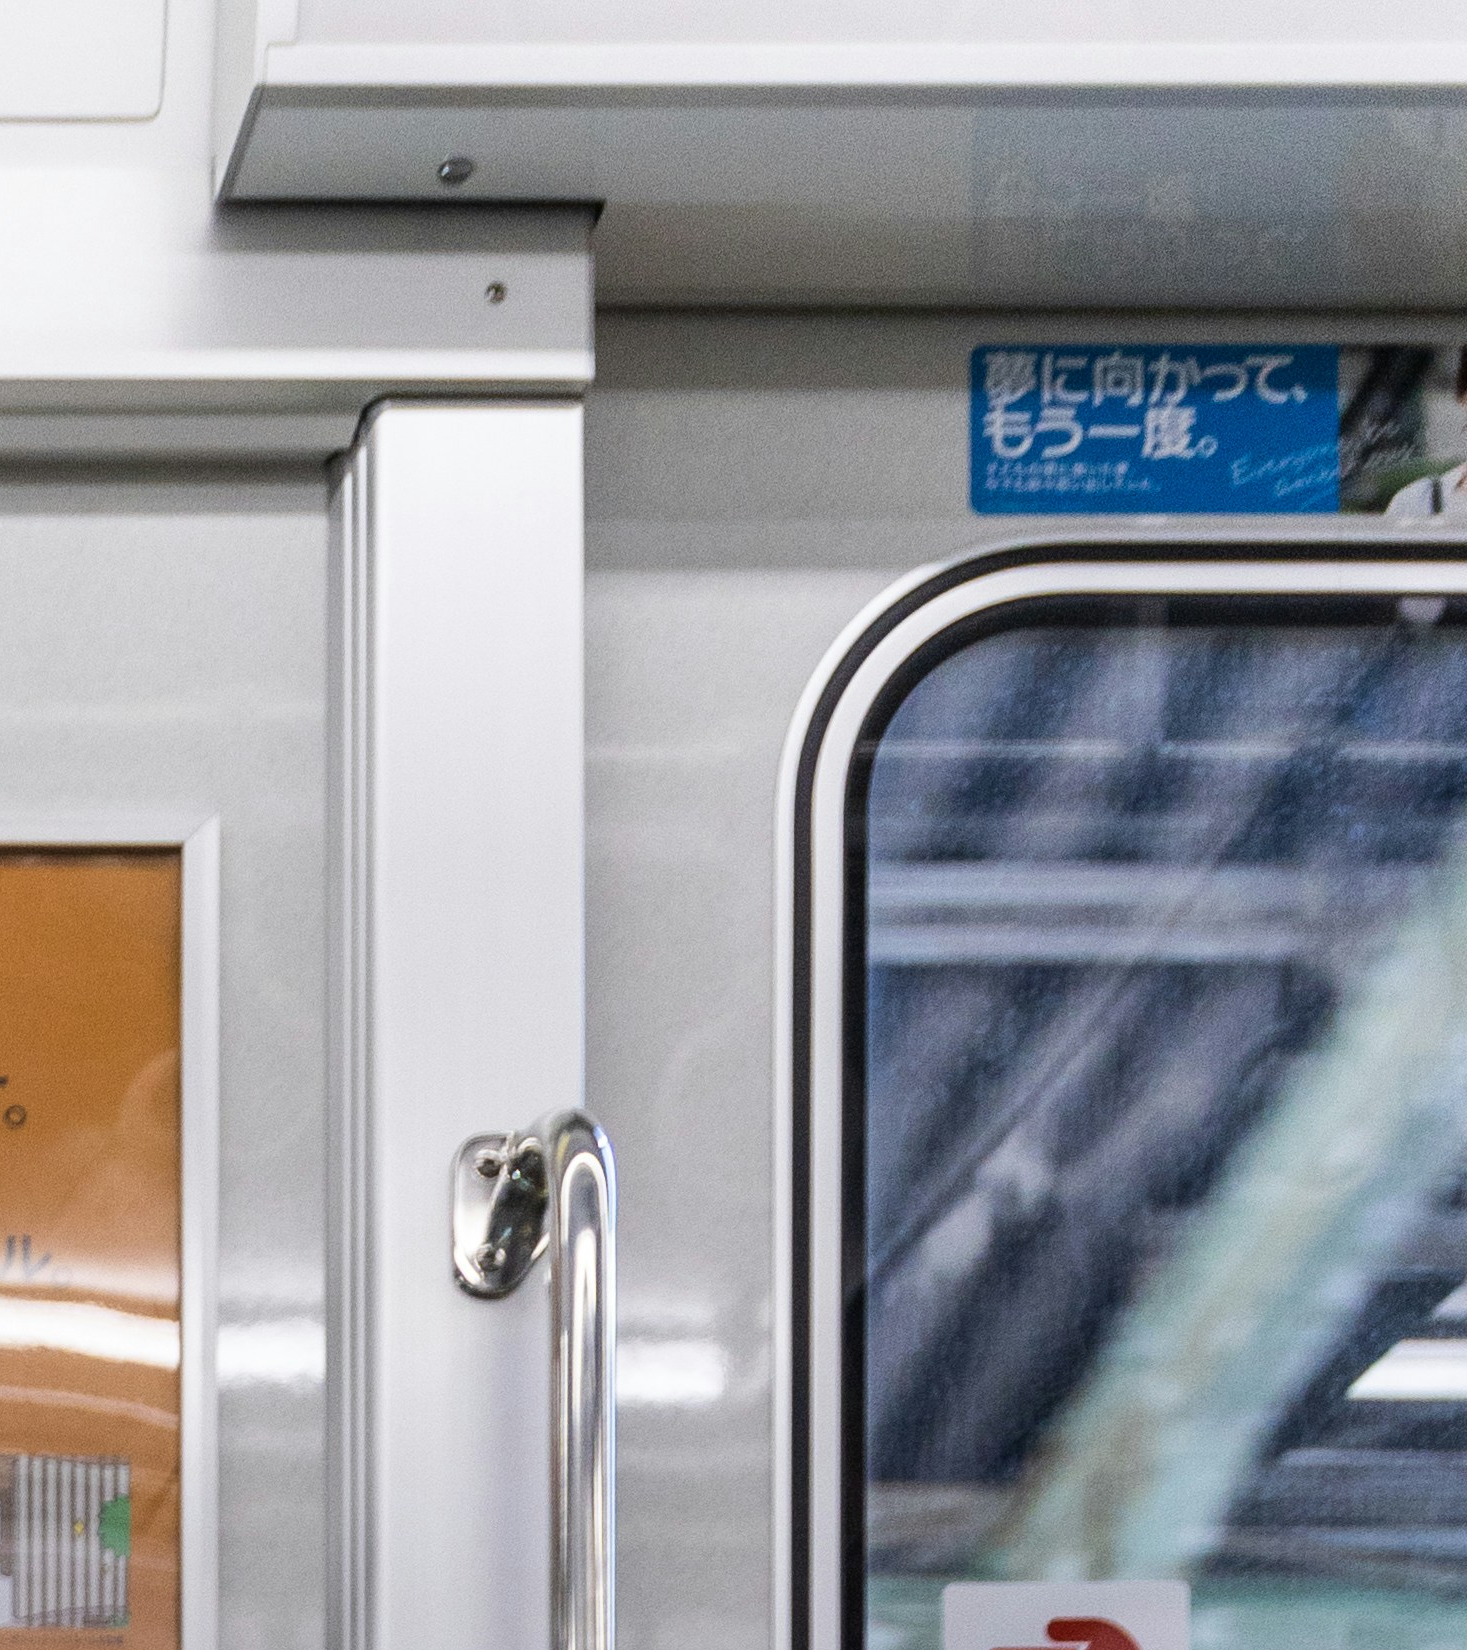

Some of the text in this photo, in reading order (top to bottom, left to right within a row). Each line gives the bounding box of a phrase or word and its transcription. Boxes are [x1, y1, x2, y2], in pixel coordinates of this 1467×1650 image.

[983, 351, 1309, 404] 夢に向かって、
[983, 403, 1219, 459] もう一度。
